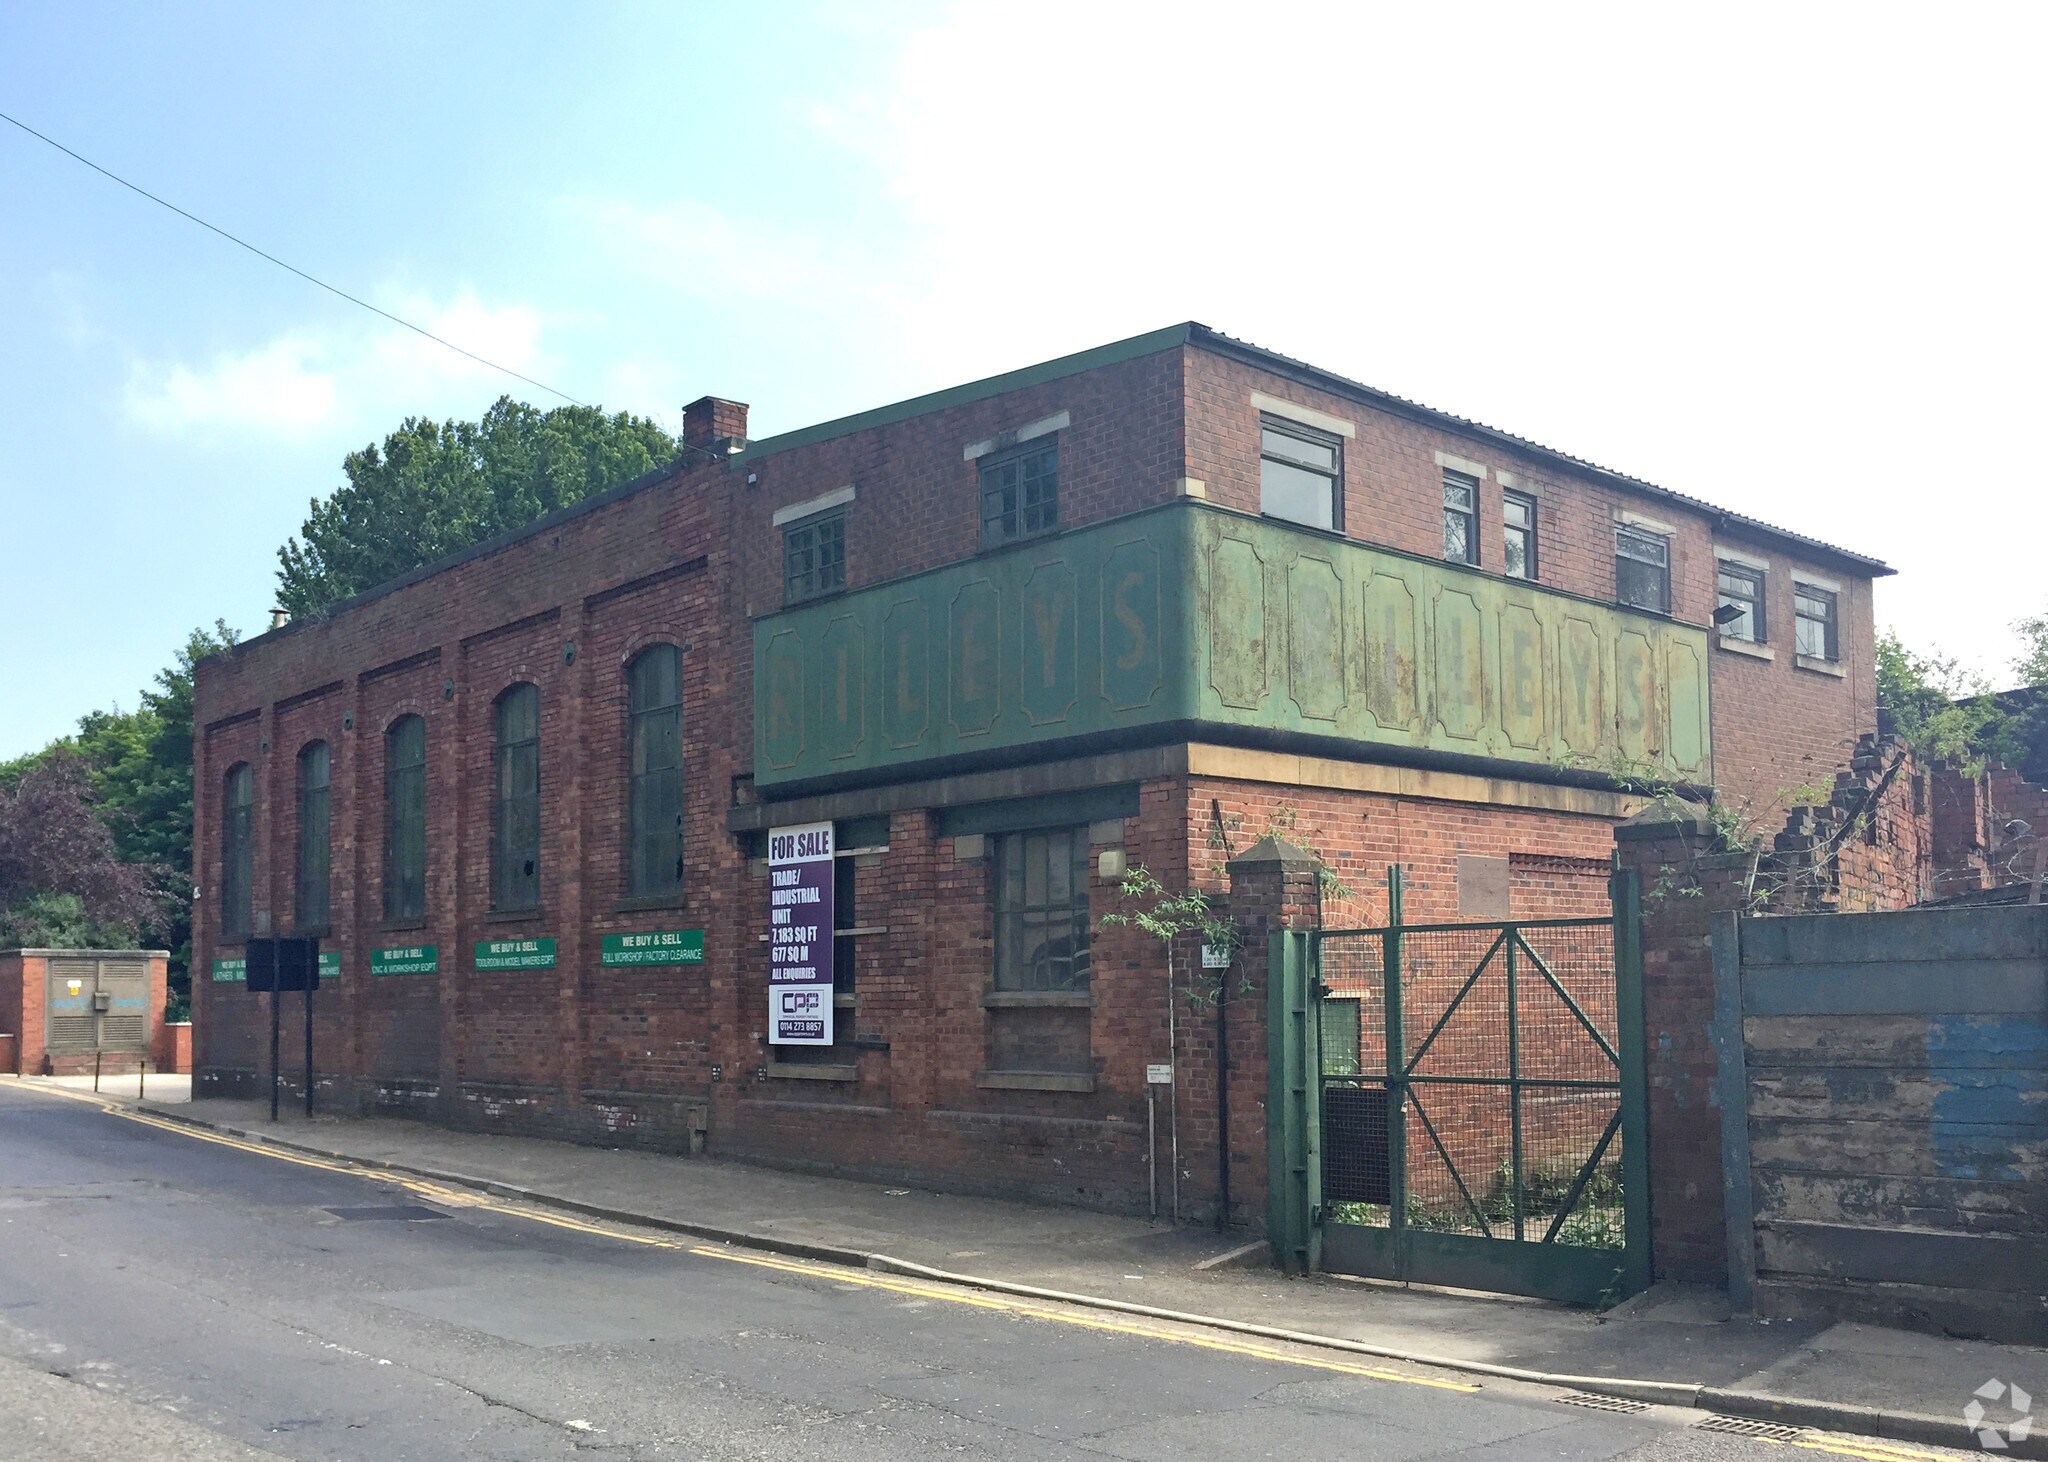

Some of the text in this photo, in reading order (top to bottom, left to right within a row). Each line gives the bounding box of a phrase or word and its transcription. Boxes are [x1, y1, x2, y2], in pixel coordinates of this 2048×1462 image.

[770, 570, 1150, 738] RILEYS
[772, 831, 829, 860] FOR SALE
[772, 868, 801, 887] TRADE/
[772, 887, 820, 906] INDUSTRIAL
[772, 909, 791, 924] UNIT
[622, 934, 682, 947] WE BUY & SELL
[772, 926, 818, 944] 7,183 SQ FT
[490, 944, 500, 953] WE
[501, 943, 515, 952] BUY
[522, 941, 538, 951] SELL
[772, 945, 809, 963] 677 SQ M
[603, 952, 614, 963] FULL
[615, 951, 643, 962] WORKSHOP
[646, 950, 670, 961] FACTORY
[670, 949, 702, 960] CLEARANCE
[389, 963, 420, 973] WORKSHOP
[772, 966, 816, 981] ALL ENQUIRIES
[780, 1022, 822, 1031] 0114 273 8857
